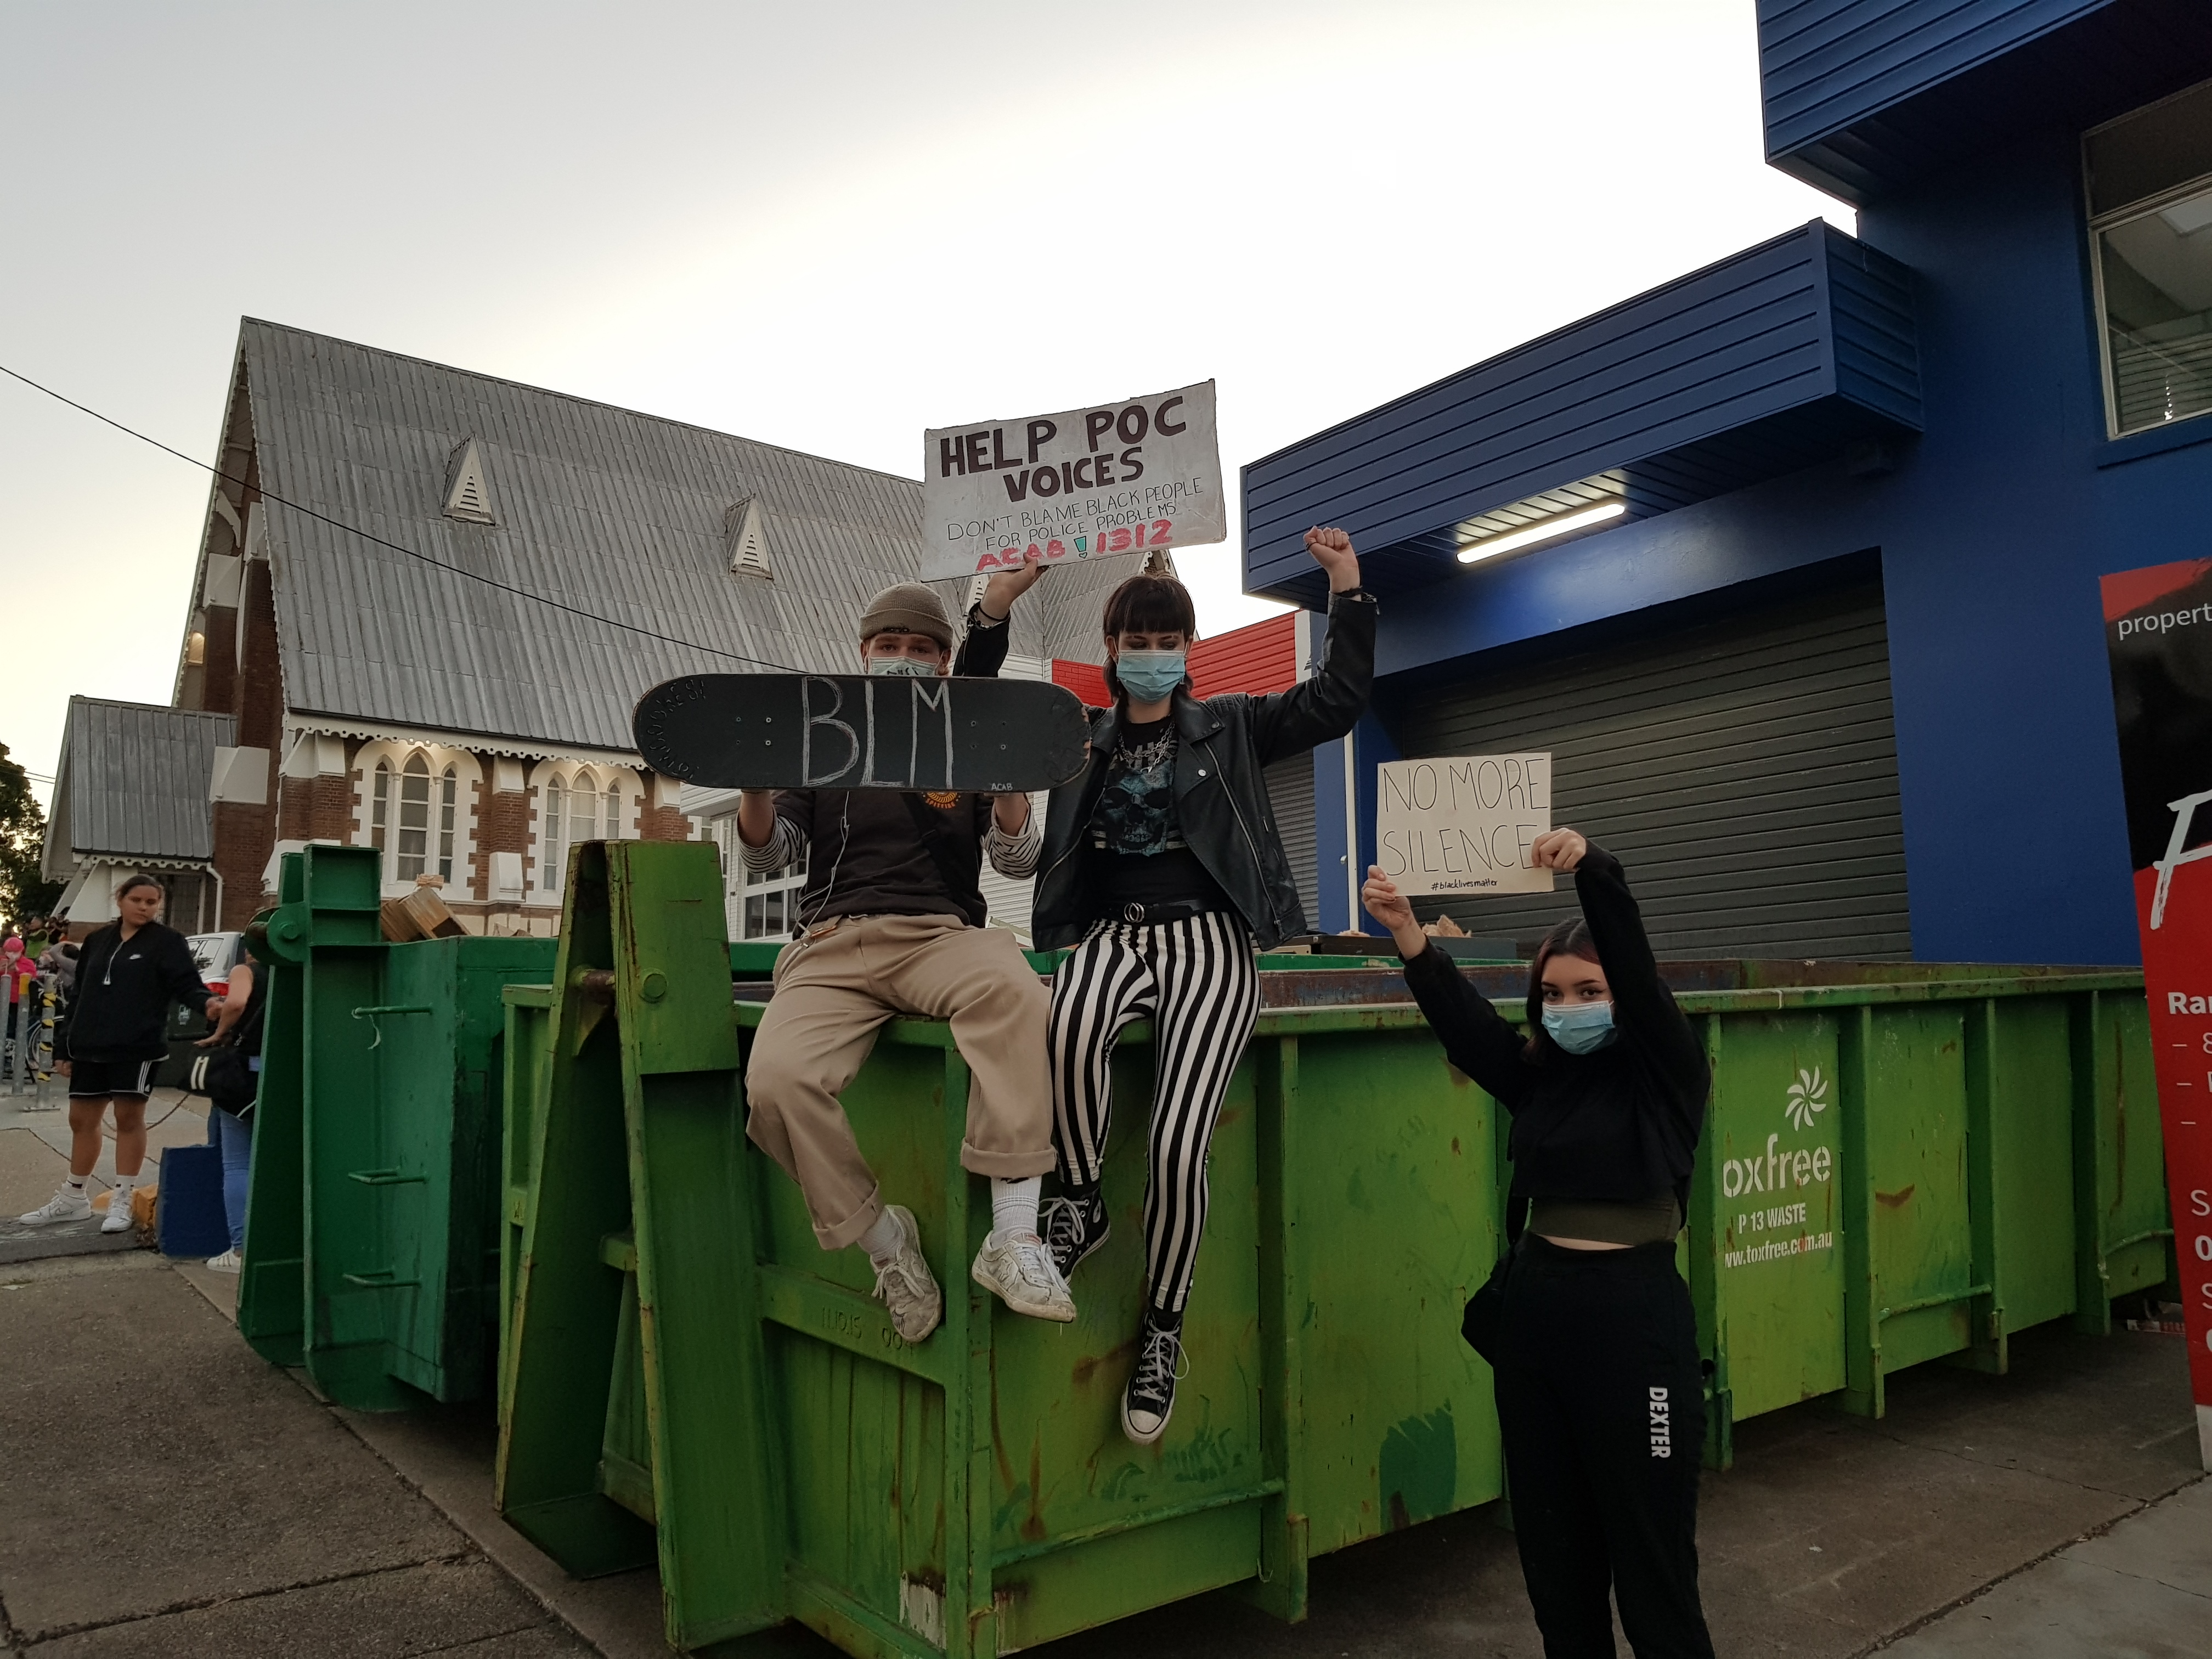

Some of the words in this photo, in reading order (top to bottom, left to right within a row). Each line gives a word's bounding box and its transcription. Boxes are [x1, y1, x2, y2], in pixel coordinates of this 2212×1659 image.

[940, 420, 1057, 477] HELP
[1086, 396, 1186, 453] POC
[1003, 447, 1144, 503] VOICES
[947, 515, 1013, 540] DON'T
[1021, 503, 1081, 528] BLAME
[1087, 490, 1139, 515] BLACK
[1146, 477, 1203, 504] PEOPLE
[986, 532, 1021, 550] FOR
[1029, 521, 1088, 542] POLICE
[1096, 502, 1176, 529] PROBLEMS
[975, 539, 1066, 571] ACAB
[1096, 519, 1173, 554] 1312
[2118, 603, 2212, 641] propert
[802, 676, 953, 789] BLM
[991, 782, 1013, 791] ACAB
[1383, 764, 1437, 812] NO
[1449, 758, 1548, 810] MORE
[1384, 825, 1542, 876] SILENCE
[1431, 878, 1498, 891] #blacklivesmatter
[1767, 1202, 1807, 1228] WASTE
[1649, 1386, 1671, 1458] DEXTER
